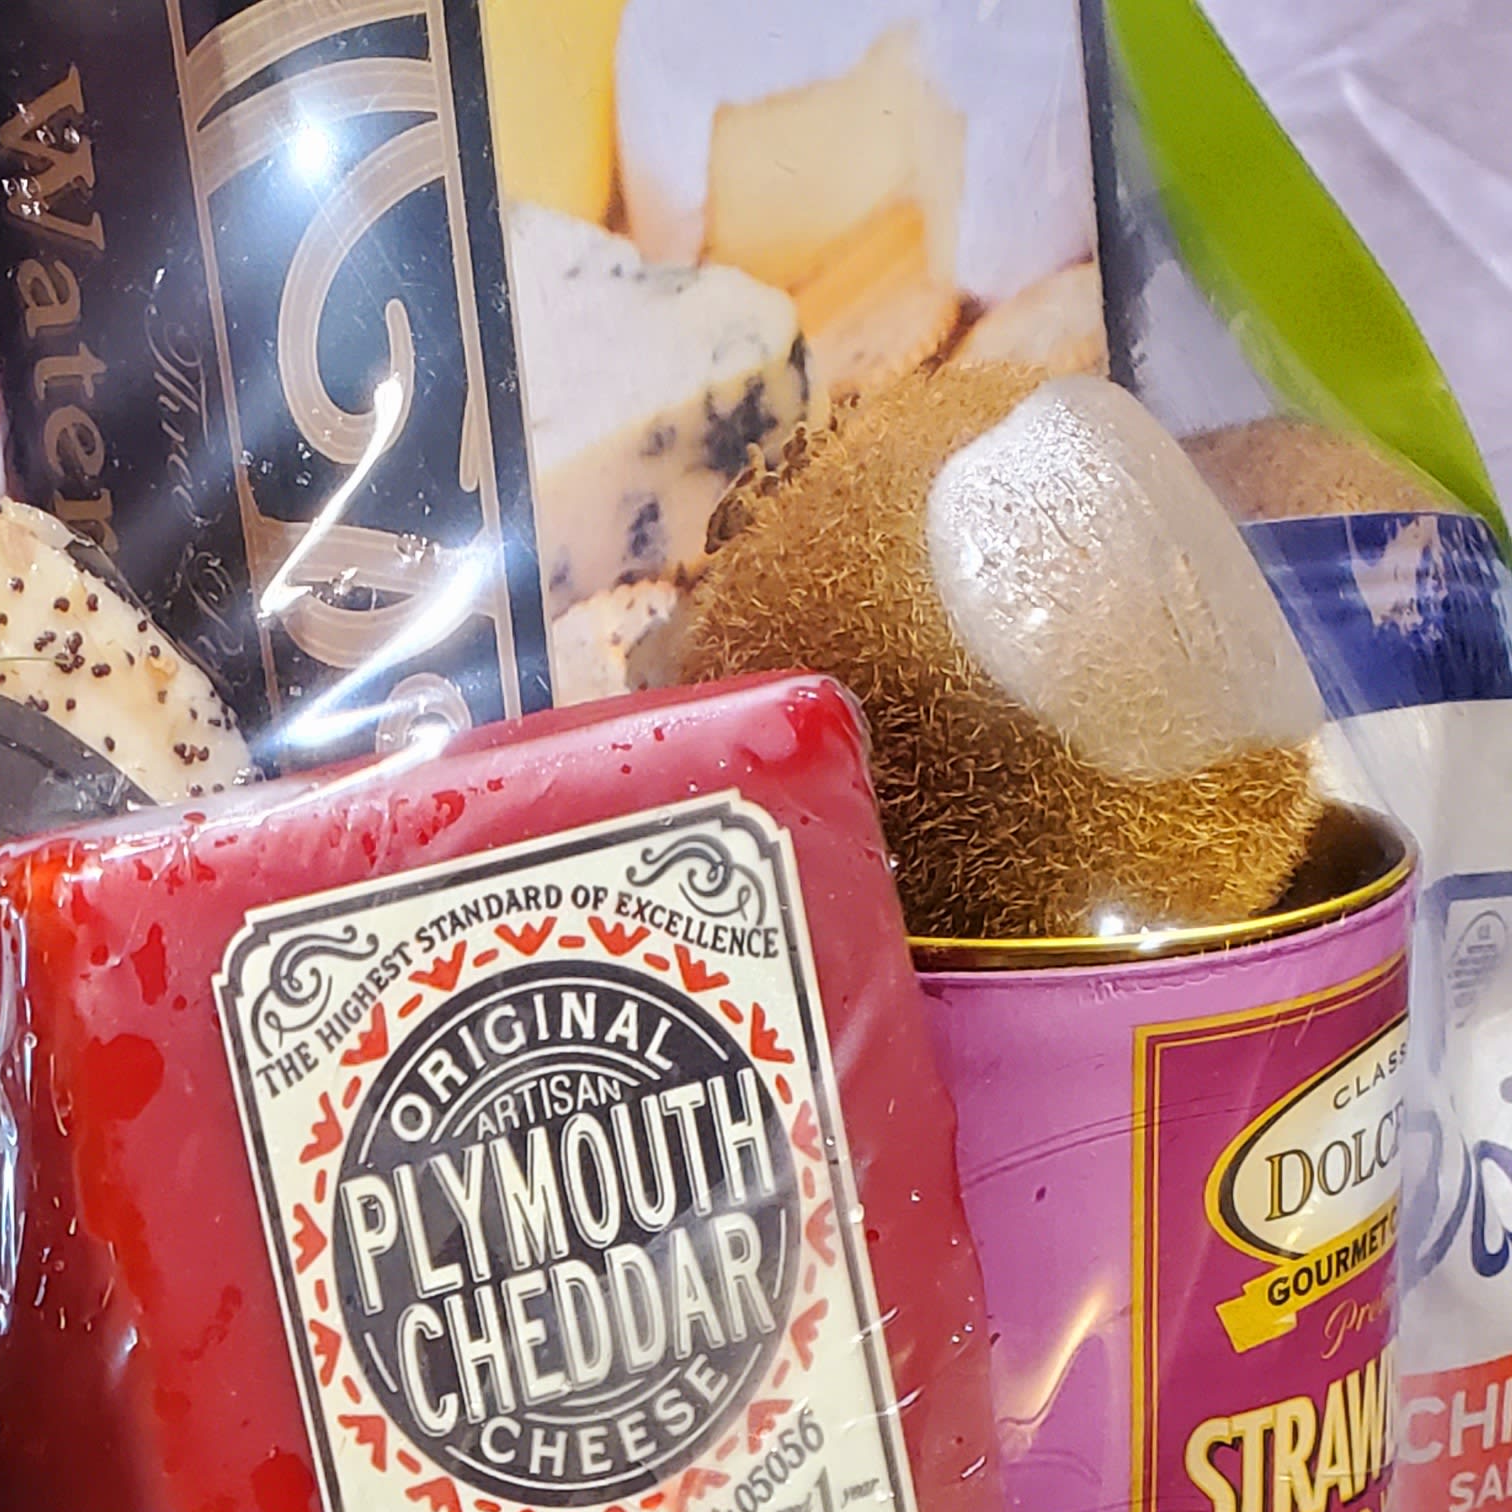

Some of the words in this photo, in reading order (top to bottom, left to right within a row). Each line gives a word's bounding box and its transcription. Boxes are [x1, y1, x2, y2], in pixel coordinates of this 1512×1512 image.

[256, 1042, 319, 1097] THE
[315, 941, 413, 1053] HIGHEST
[415, 885, 562, 954] STANDARD
[571, 885, 608, 911] OF
[615, 891, 779, 958] EXCELLENCE
[390, 990, 674, 1143] ORIGINAL
[477, 1073, 621, 1141] ARTISAN
[338, 1067, 776, 1316] PLYMOUTH
[396, 1209, 776, 1438] CHEDDAR
[1267, 1221, 1388, 1306] GOURMET
[480, 1354, 730, 1478] CHEESE
[841, 1478, 880, 1509] year
